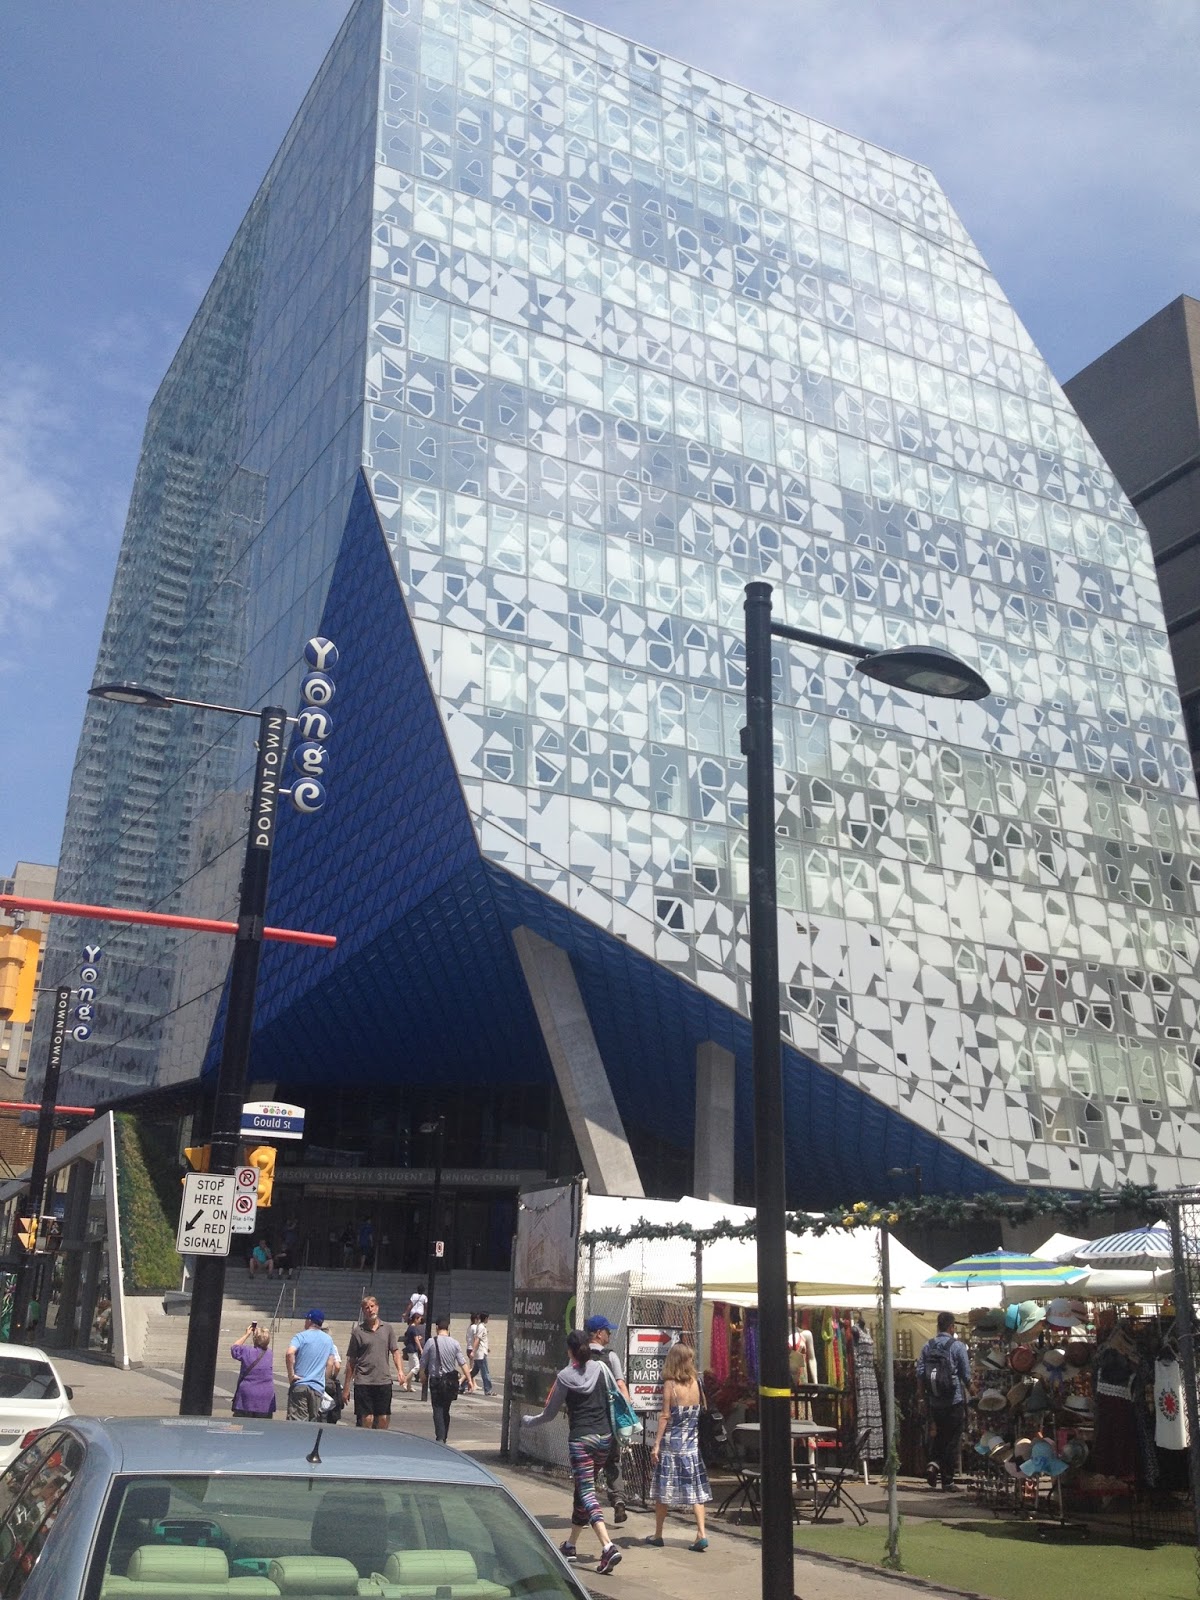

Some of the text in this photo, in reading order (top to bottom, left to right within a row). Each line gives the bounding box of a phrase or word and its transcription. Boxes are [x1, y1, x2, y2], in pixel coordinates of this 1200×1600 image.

[295, 637, 335, 812] Yonge
[256, 717, 282, 846] DOWNTOWN
[253, 1116, 291, 1129] Gould St
[314, 1172, 373, 1181] UNIVERSITY
[377, 1172, 423, 1181] STUDENT
[482, 1173, 520, 1183] CENTRE
[197, 1180, 224, 1191] STOP
[194, 1194, 223, 1205] HERE
[213, 1209, 227, 1220] ON
[204, 1223, 226, 1234] RED
[184, 1236, 222, 1248] SIGNAL
[514, 1297, 543, 1315] For Lease
[645, 1359, 664, 1369] 888
[634, 1385, 654, 1395] OPEN
